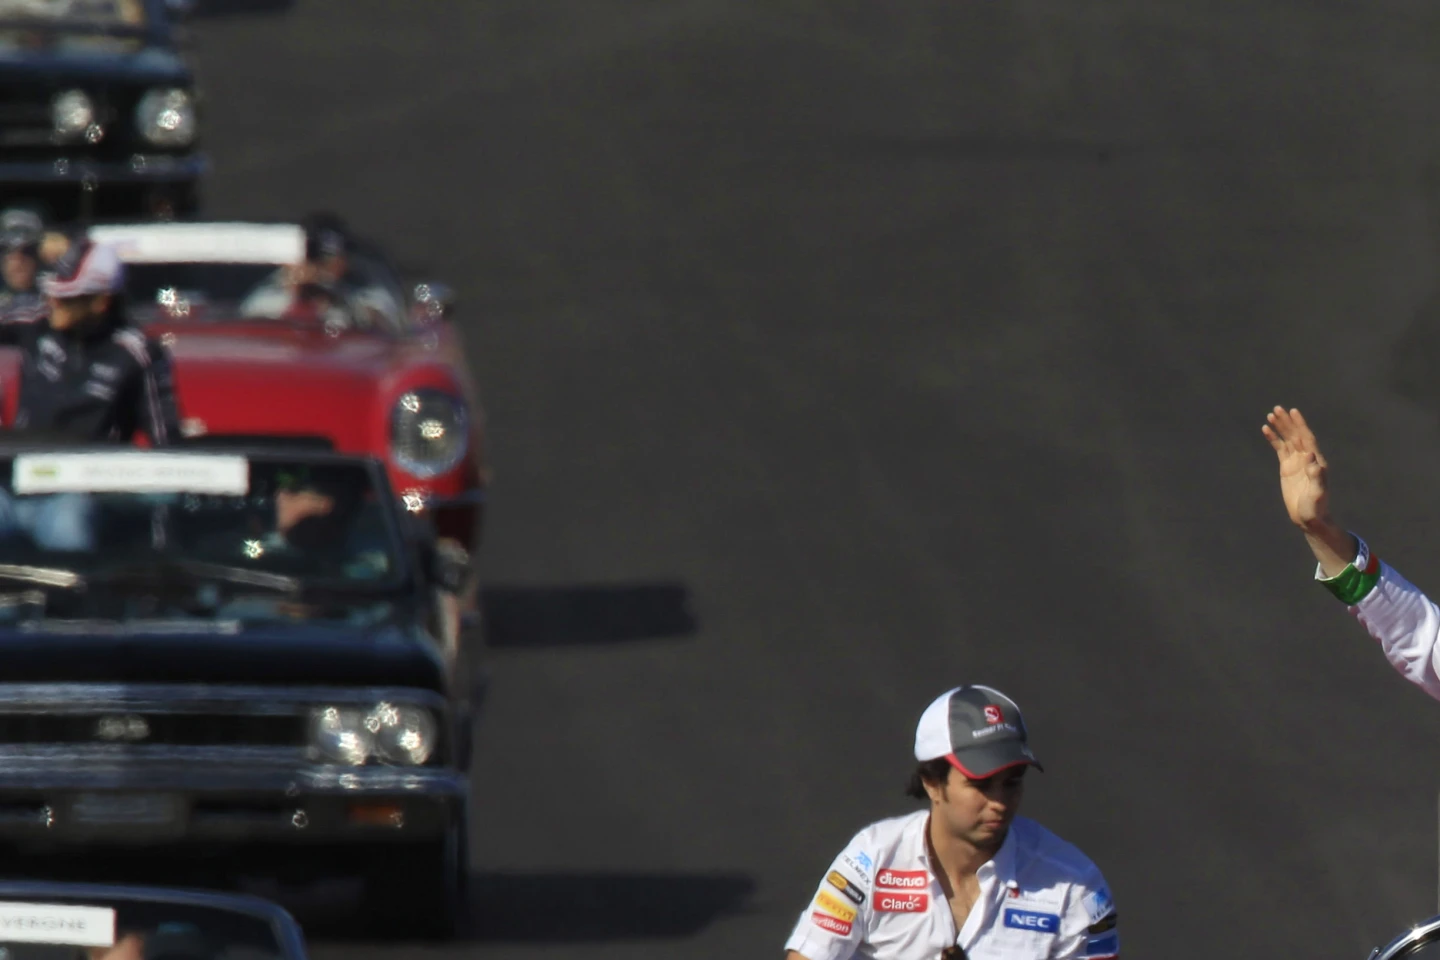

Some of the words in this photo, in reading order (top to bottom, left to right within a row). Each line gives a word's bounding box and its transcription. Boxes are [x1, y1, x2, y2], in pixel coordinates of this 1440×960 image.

[843, 856, 872, 885] TELMEX
[881, 898, 915, 910] Claro
[1010, 913, 1051, 928] NEC
